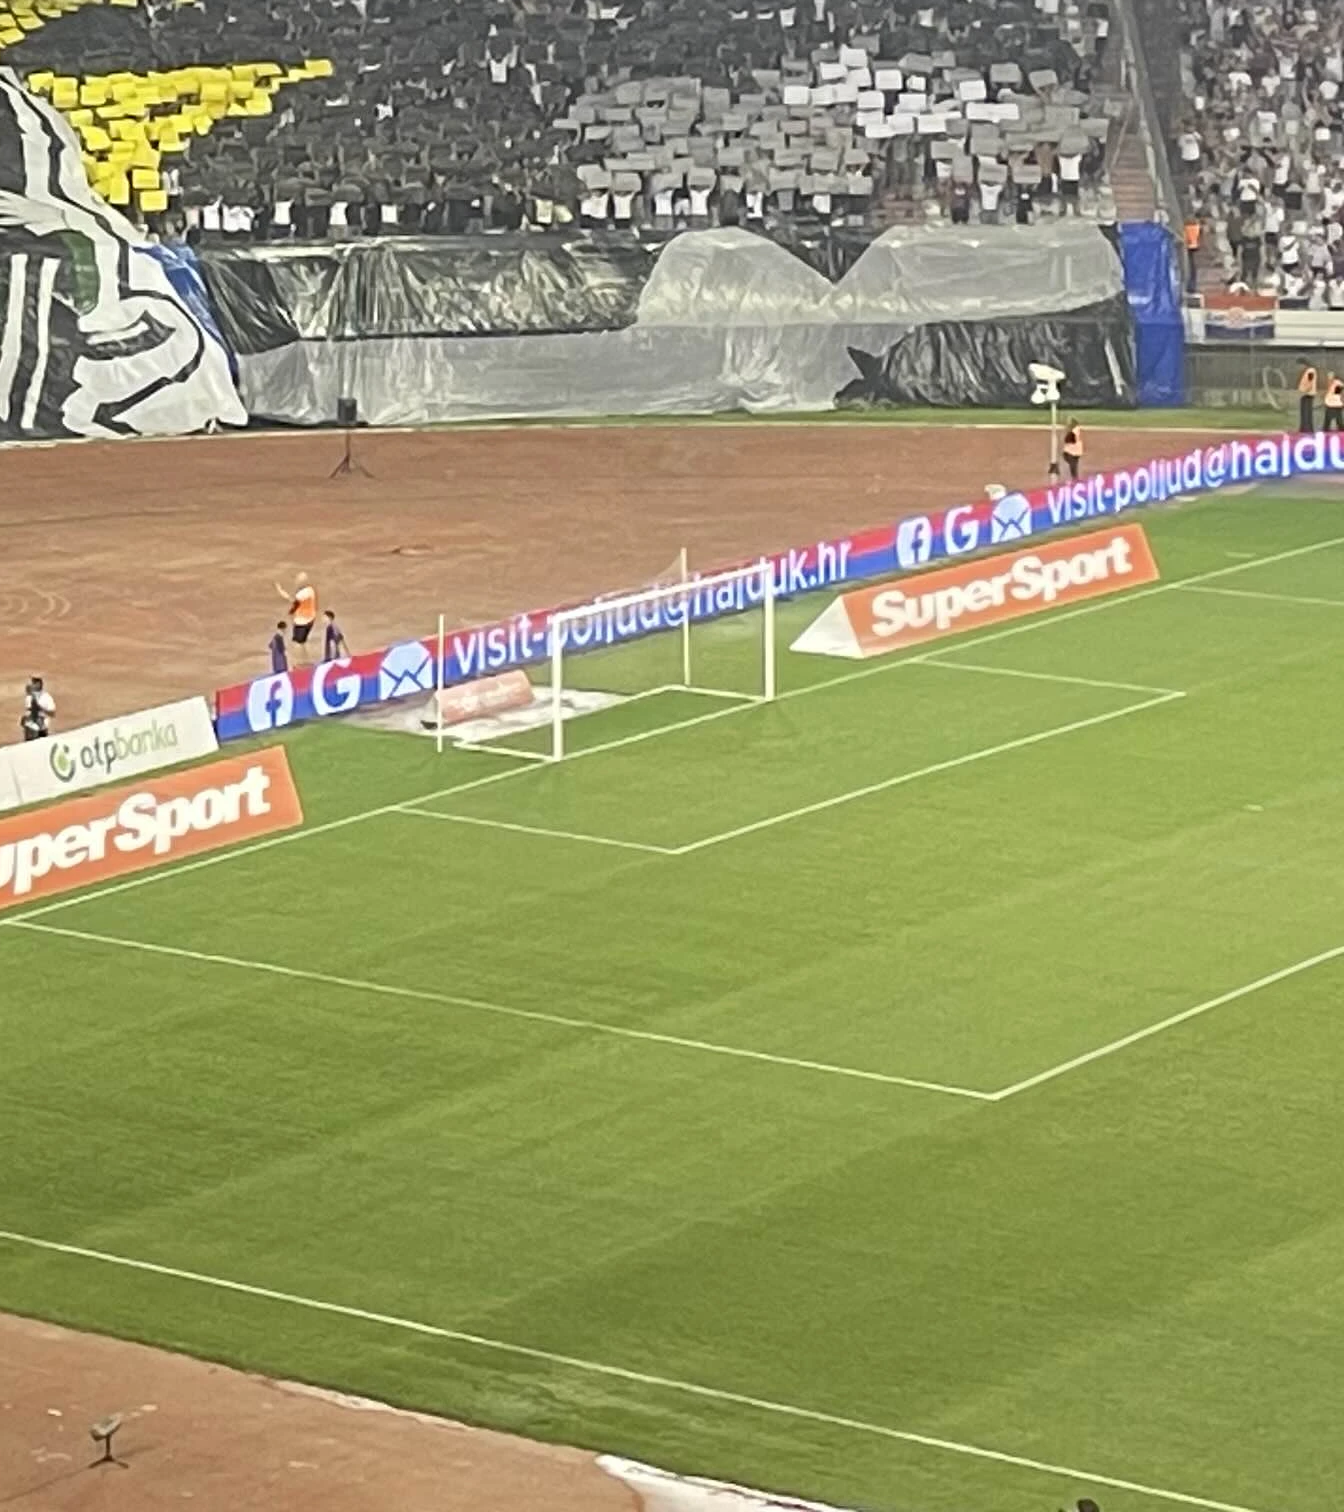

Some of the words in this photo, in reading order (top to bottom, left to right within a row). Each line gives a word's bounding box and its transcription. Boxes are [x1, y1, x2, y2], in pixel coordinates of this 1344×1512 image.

[944, 504, 980, 556] G
[871, 536, 1133, 637] SuperSport
[312, 657, 361, 716] G
